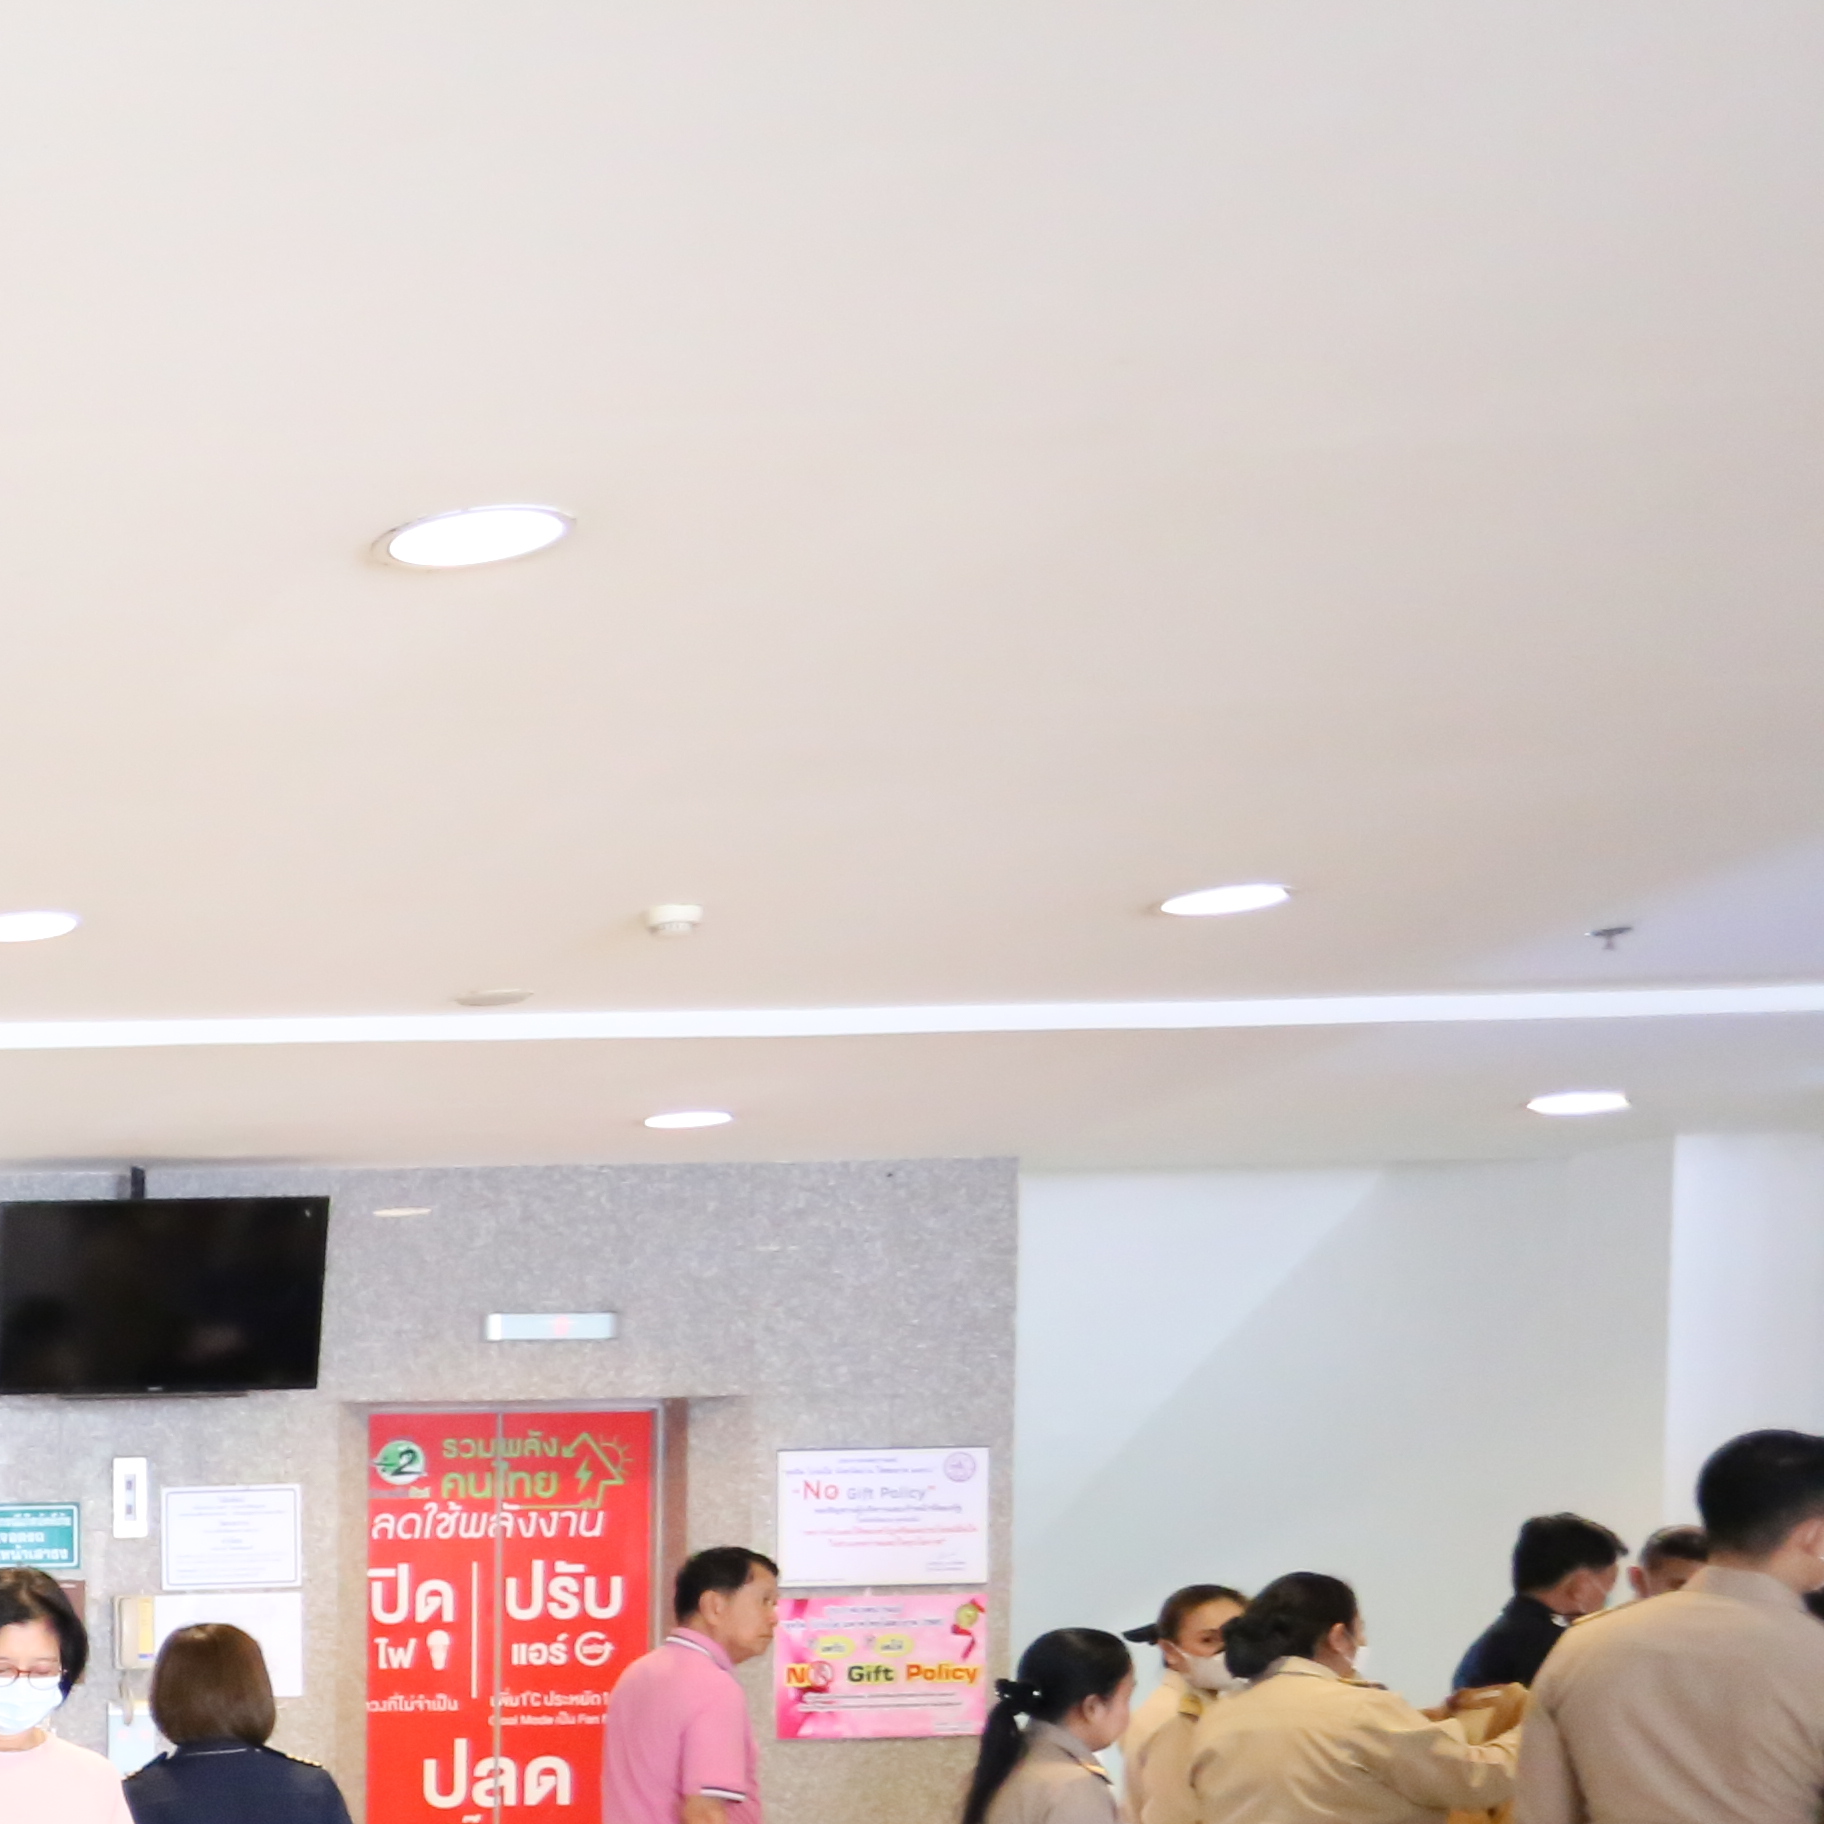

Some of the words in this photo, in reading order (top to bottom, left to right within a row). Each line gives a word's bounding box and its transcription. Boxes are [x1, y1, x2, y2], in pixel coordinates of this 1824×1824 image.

[442, 1430, 560, 1458] รวมพลัง
[441, 1459, 560, 1498] คนไทย
[371, 1501, 605, 1540] ลดใช้พลังงาน
[366, 1563, 455, 1625] ปิด
[505, 1559, 623, 1621] ปรับ
[374, 1637, 417, 1670] ไฟ
[511, 1632, 569, 1667] แอร์
[848, 1665, 895, 1683] Gift
[906, 1663, 979, 1685] Policy
[366, 1692, 460, 1713] วงที่ไม่จำเป็น
[423, 1738, 572, 1808] ปลด
